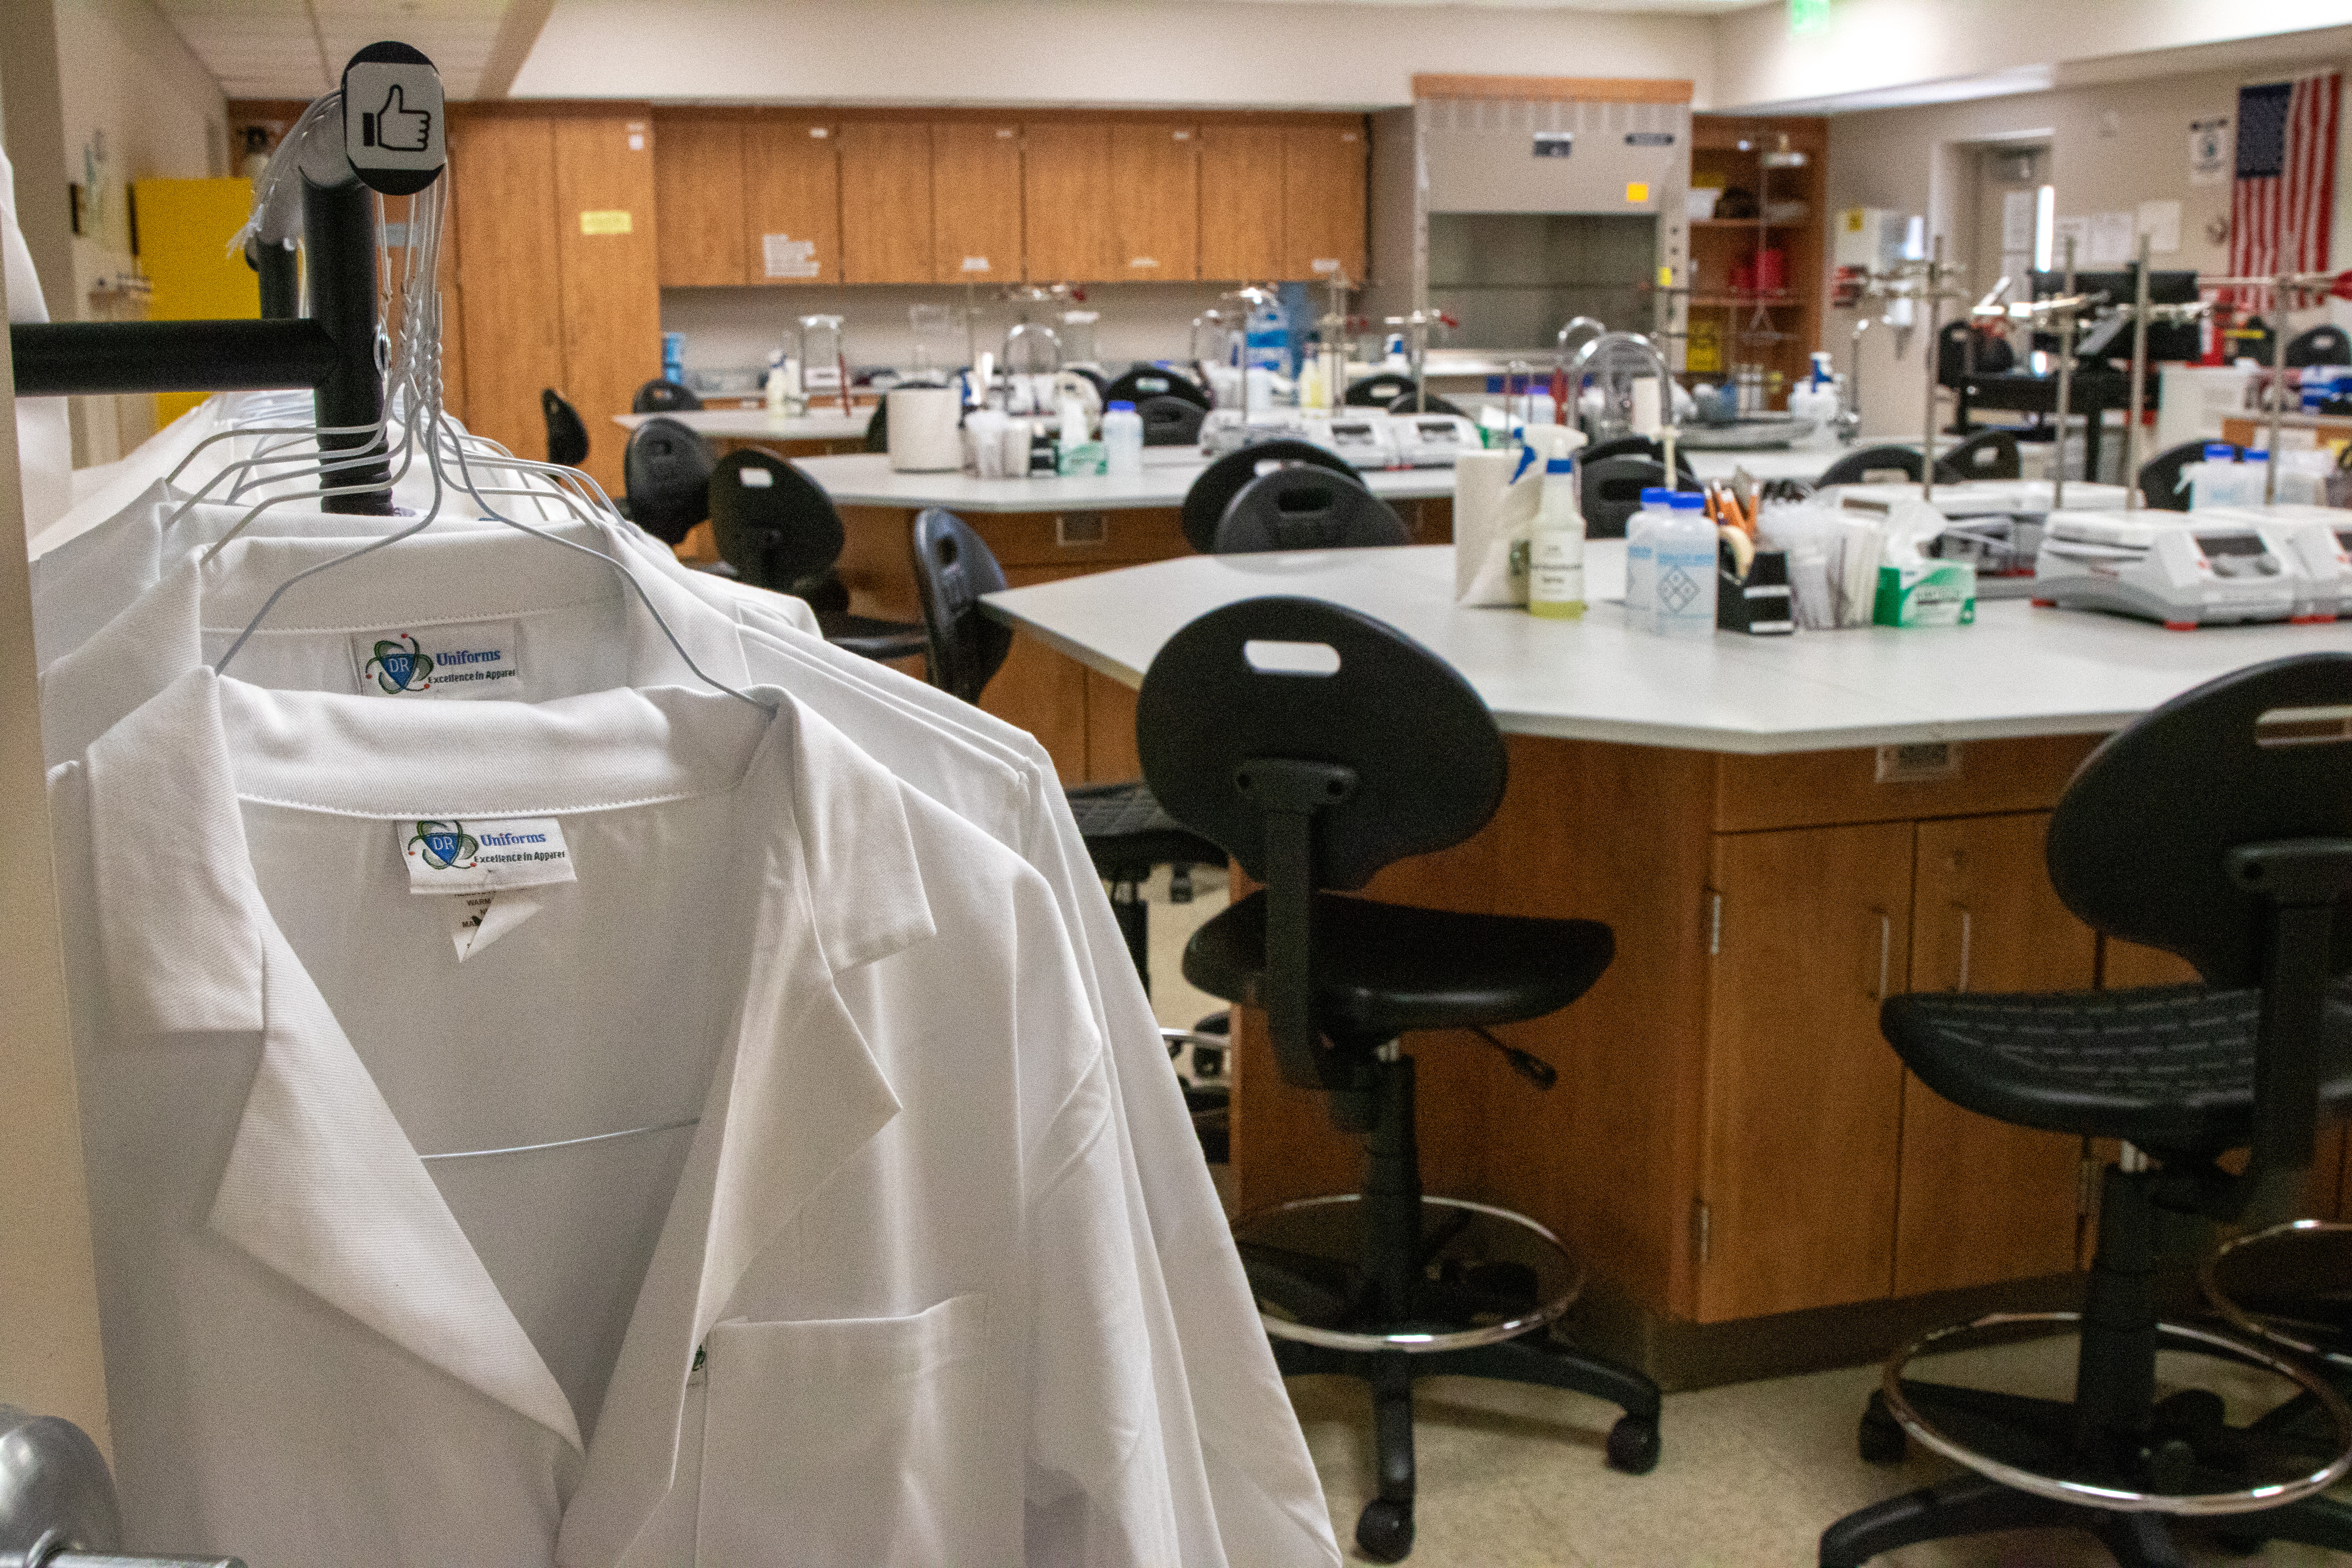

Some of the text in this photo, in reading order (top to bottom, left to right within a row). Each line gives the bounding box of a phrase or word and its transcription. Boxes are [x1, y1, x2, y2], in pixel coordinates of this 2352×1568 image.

[389, 650, 501, 672] DR Uniforms
[428, 672, 474, 683] Excellence
[486, 670, 515, 680] Apparel
[433, 833, 546, 850] DR Uniforms
[474, 854, 522, 863] Excellence
[534, 851, 565, 861] Apparel
